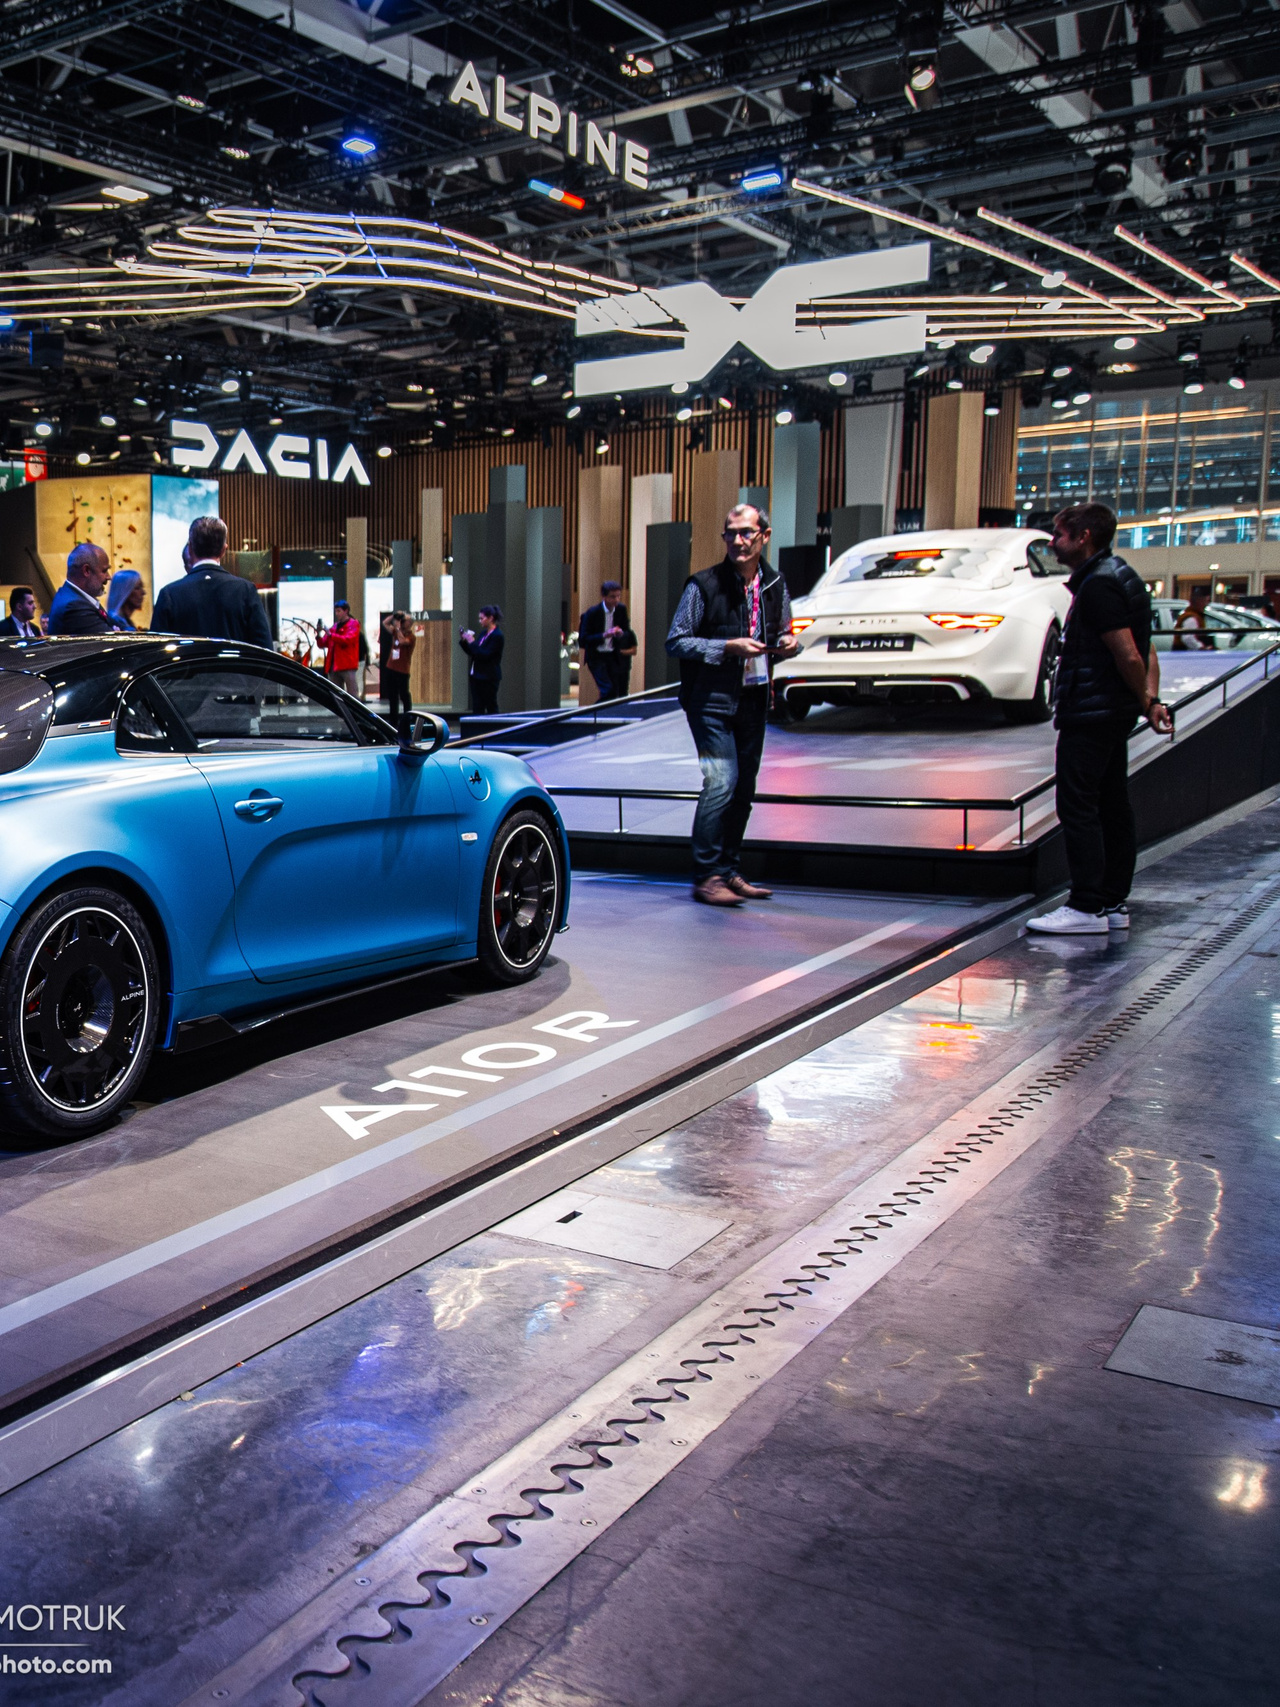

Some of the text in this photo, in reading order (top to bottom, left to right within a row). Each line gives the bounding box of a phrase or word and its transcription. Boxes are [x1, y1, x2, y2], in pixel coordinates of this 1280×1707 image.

[450, 61, 649, 190] ALPINE
[171, 419, 371, 486] DACIA
[836, 639, 905, 649] ALPINE
[121, 989, 145, 1002] ALPINE
[320, 1011, 640, 1140] A110R
